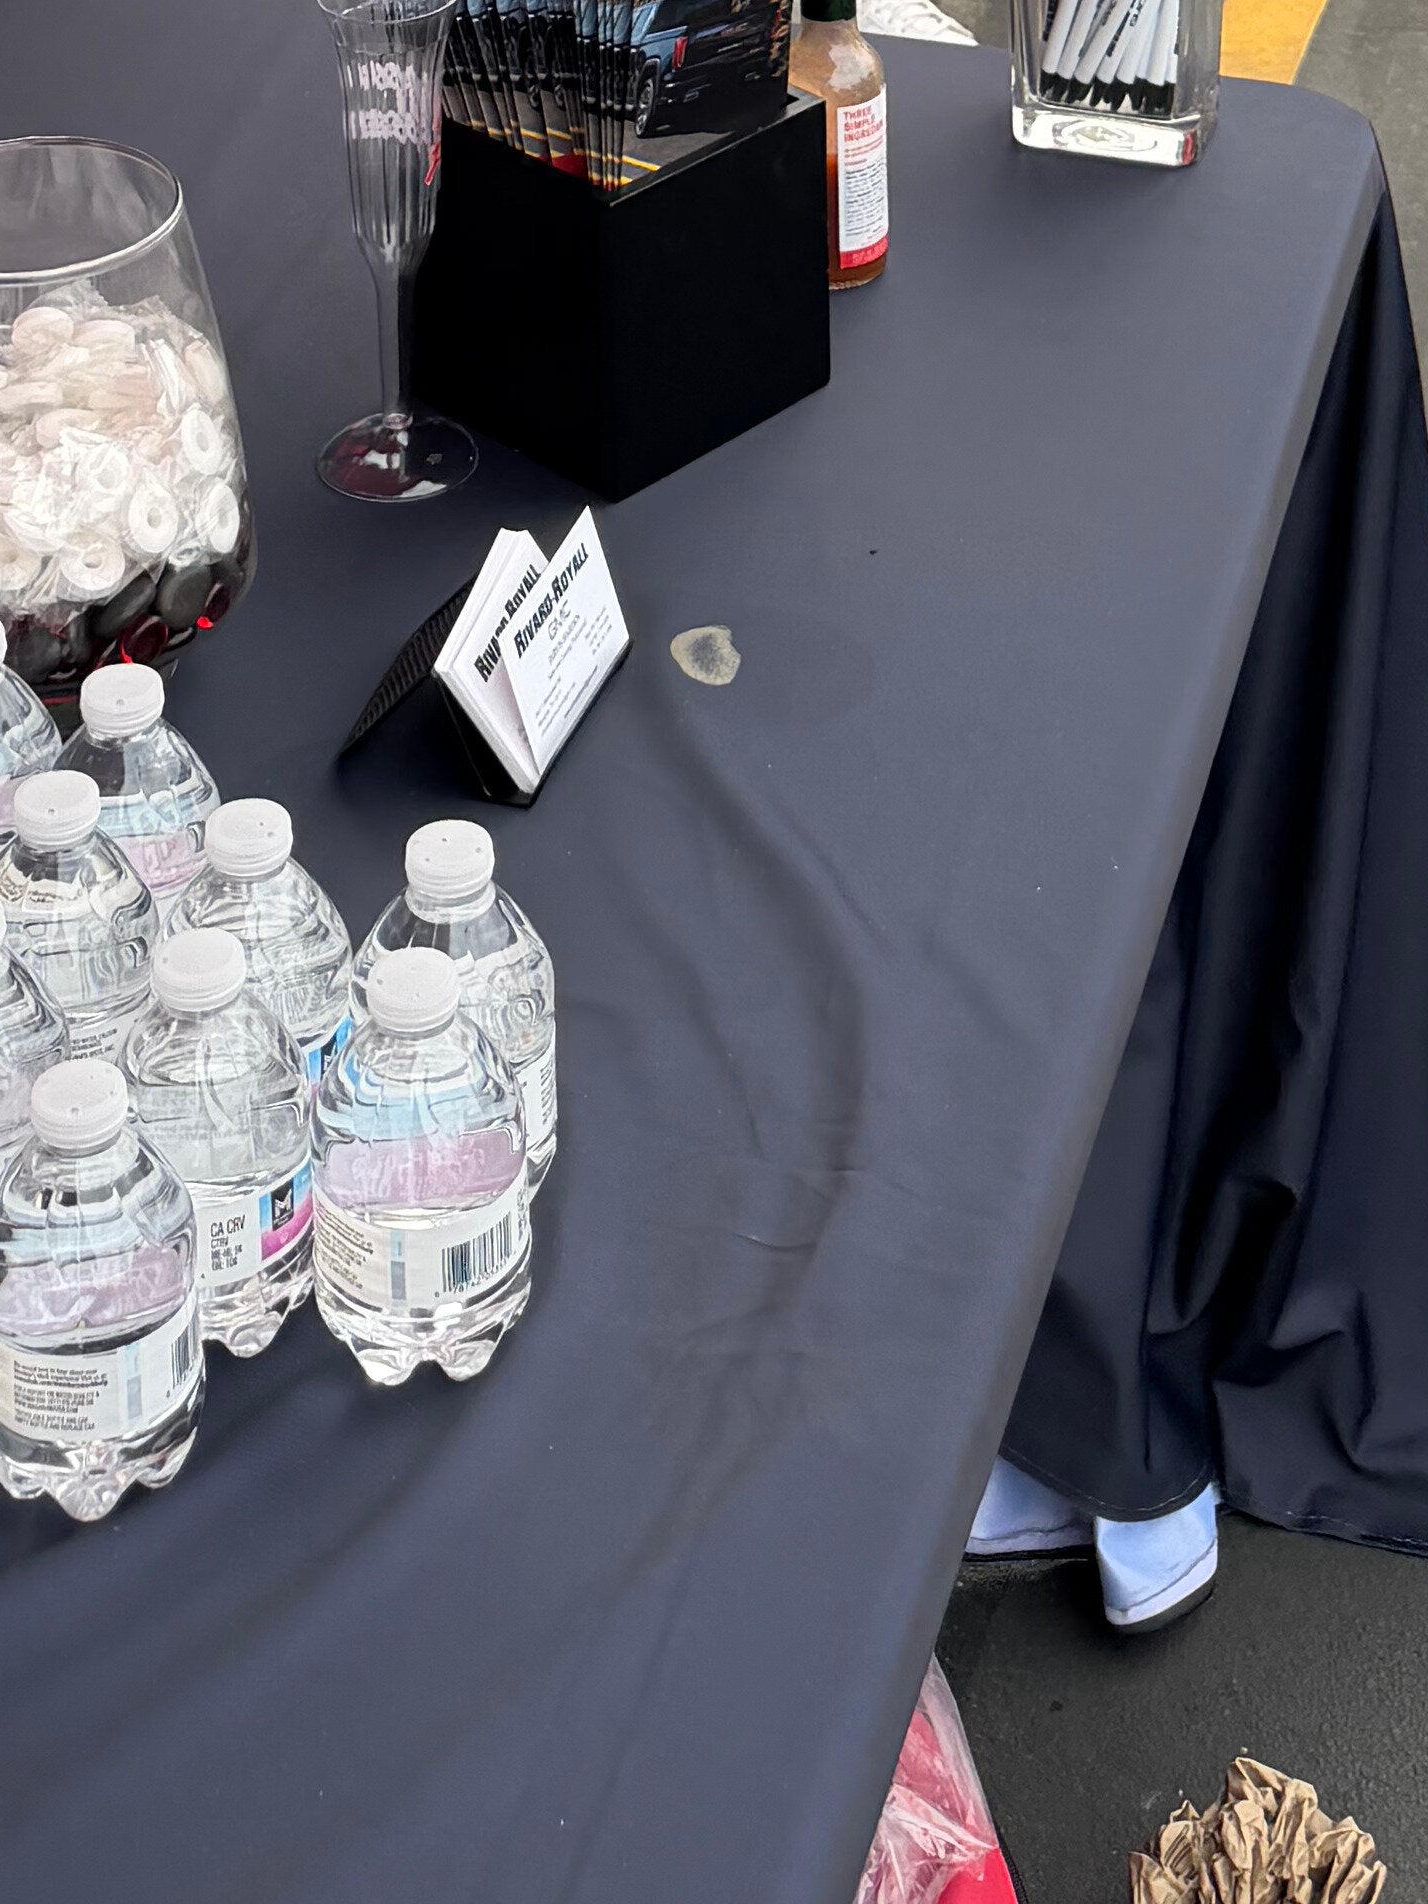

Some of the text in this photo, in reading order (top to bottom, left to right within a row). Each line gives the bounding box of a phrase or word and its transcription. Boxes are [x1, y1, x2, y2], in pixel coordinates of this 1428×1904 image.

[843, 106, 872, 121] THREE
[513, 542, 589, 660] RIVARD-ROYALL
[210, 1214, 246, 1238] CA CRV
